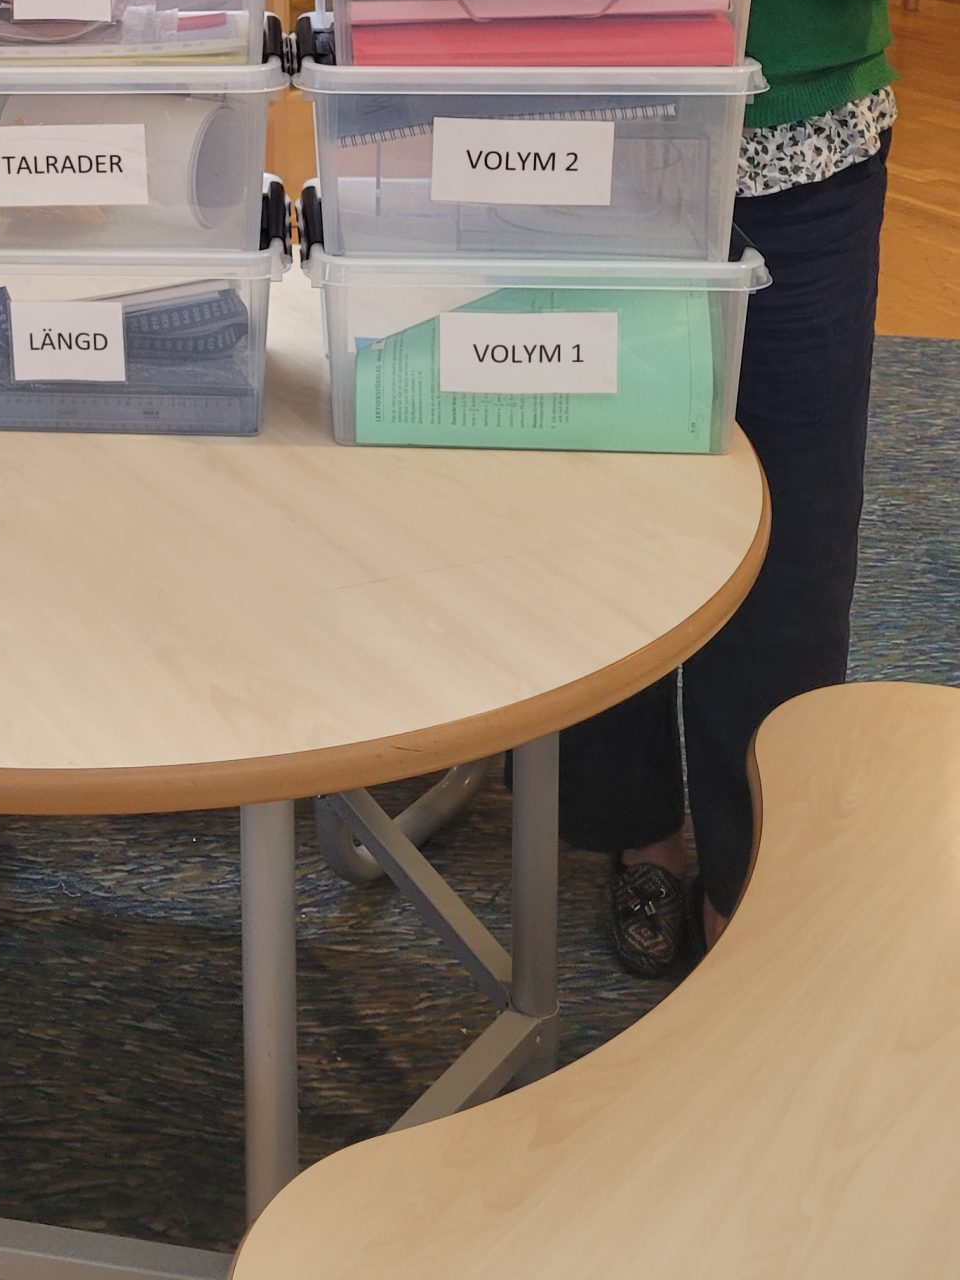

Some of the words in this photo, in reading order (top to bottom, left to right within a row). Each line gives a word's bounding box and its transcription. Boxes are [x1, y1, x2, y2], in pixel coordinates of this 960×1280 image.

[1, 154, 124, 175] TALRADER
[466, 149, 556, 172] VOLYM
[564, 151, 579, 172] 2
[29, 328, 108, 351] LÄNGD
[472, 343, 561, 364] VOLYM
[571, 343, 584, 363] 1
